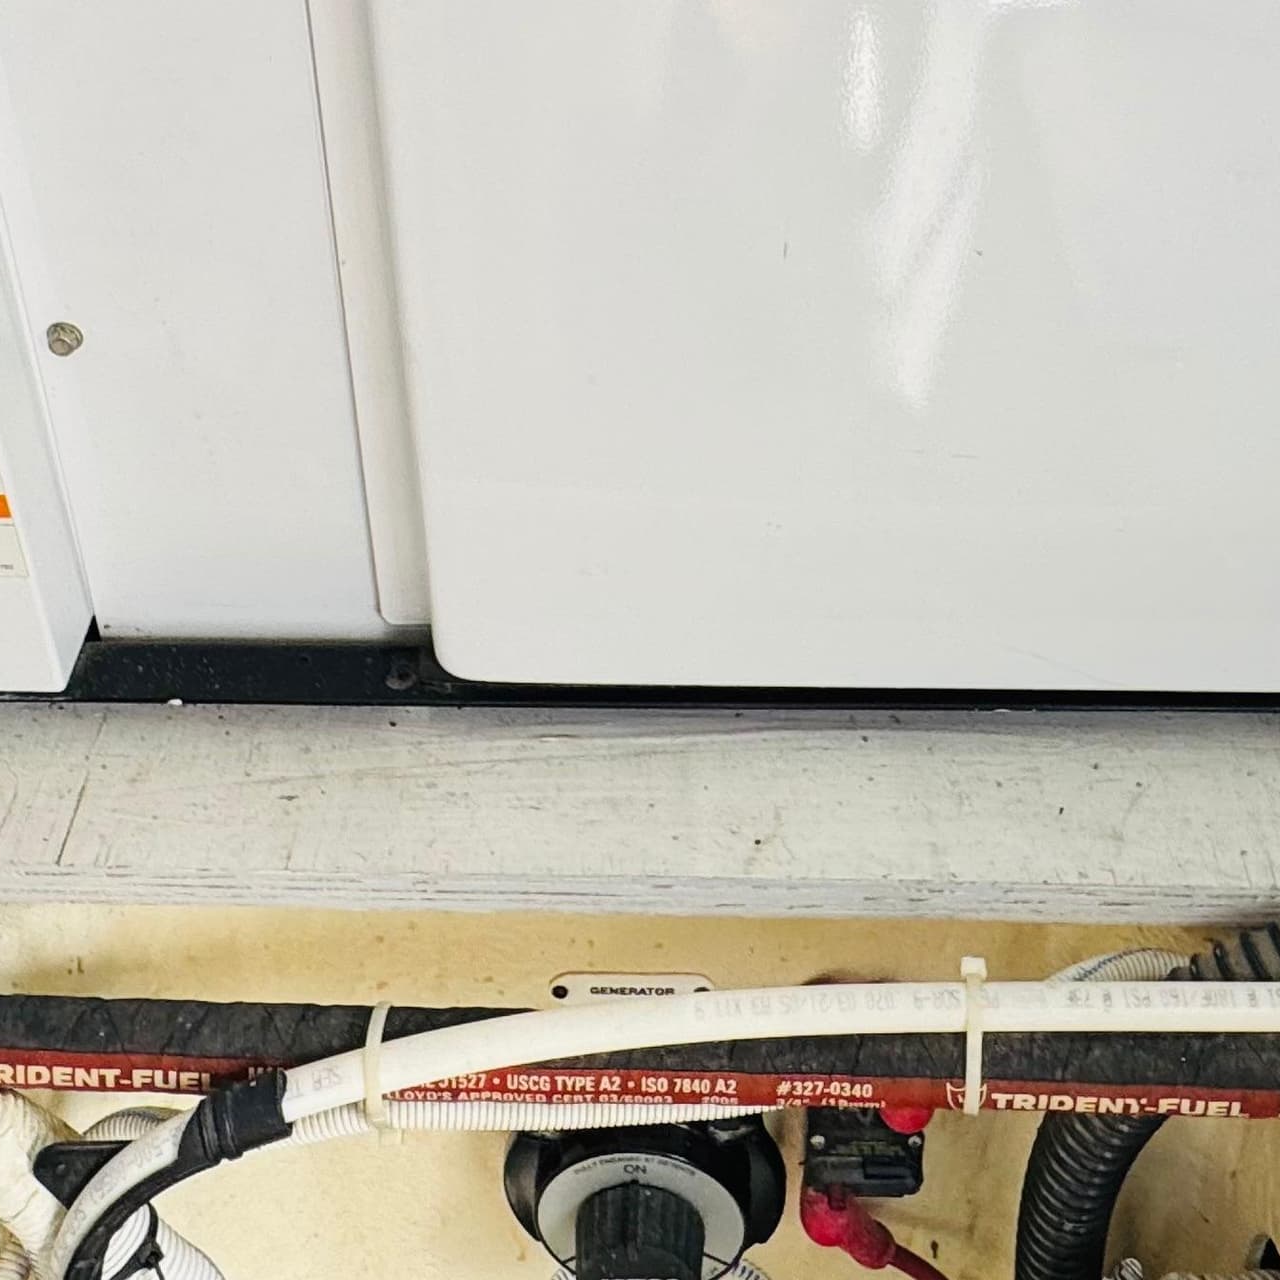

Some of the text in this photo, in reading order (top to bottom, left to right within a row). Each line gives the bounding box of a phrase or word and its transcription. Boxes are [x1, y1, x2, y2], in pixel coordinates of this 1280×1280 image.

[590, 986, 675, 996] GENERATOR
[506, 1075, 551, 1091] USCG
[553, 1075, 595, 1091] TYPE
[598, 1076, 621, 1091] A2
[641, 1077, 669, 1093] ISO
[673, 1078, 711, 1094] 7840
[714, 1079, 737, 1094] A2
[776, 1081, 873, 1098] #327-0340
[991, 1093, 1250, 1117] TRIDENT-FUEL
[623, 1164, 647, 1174] ON
